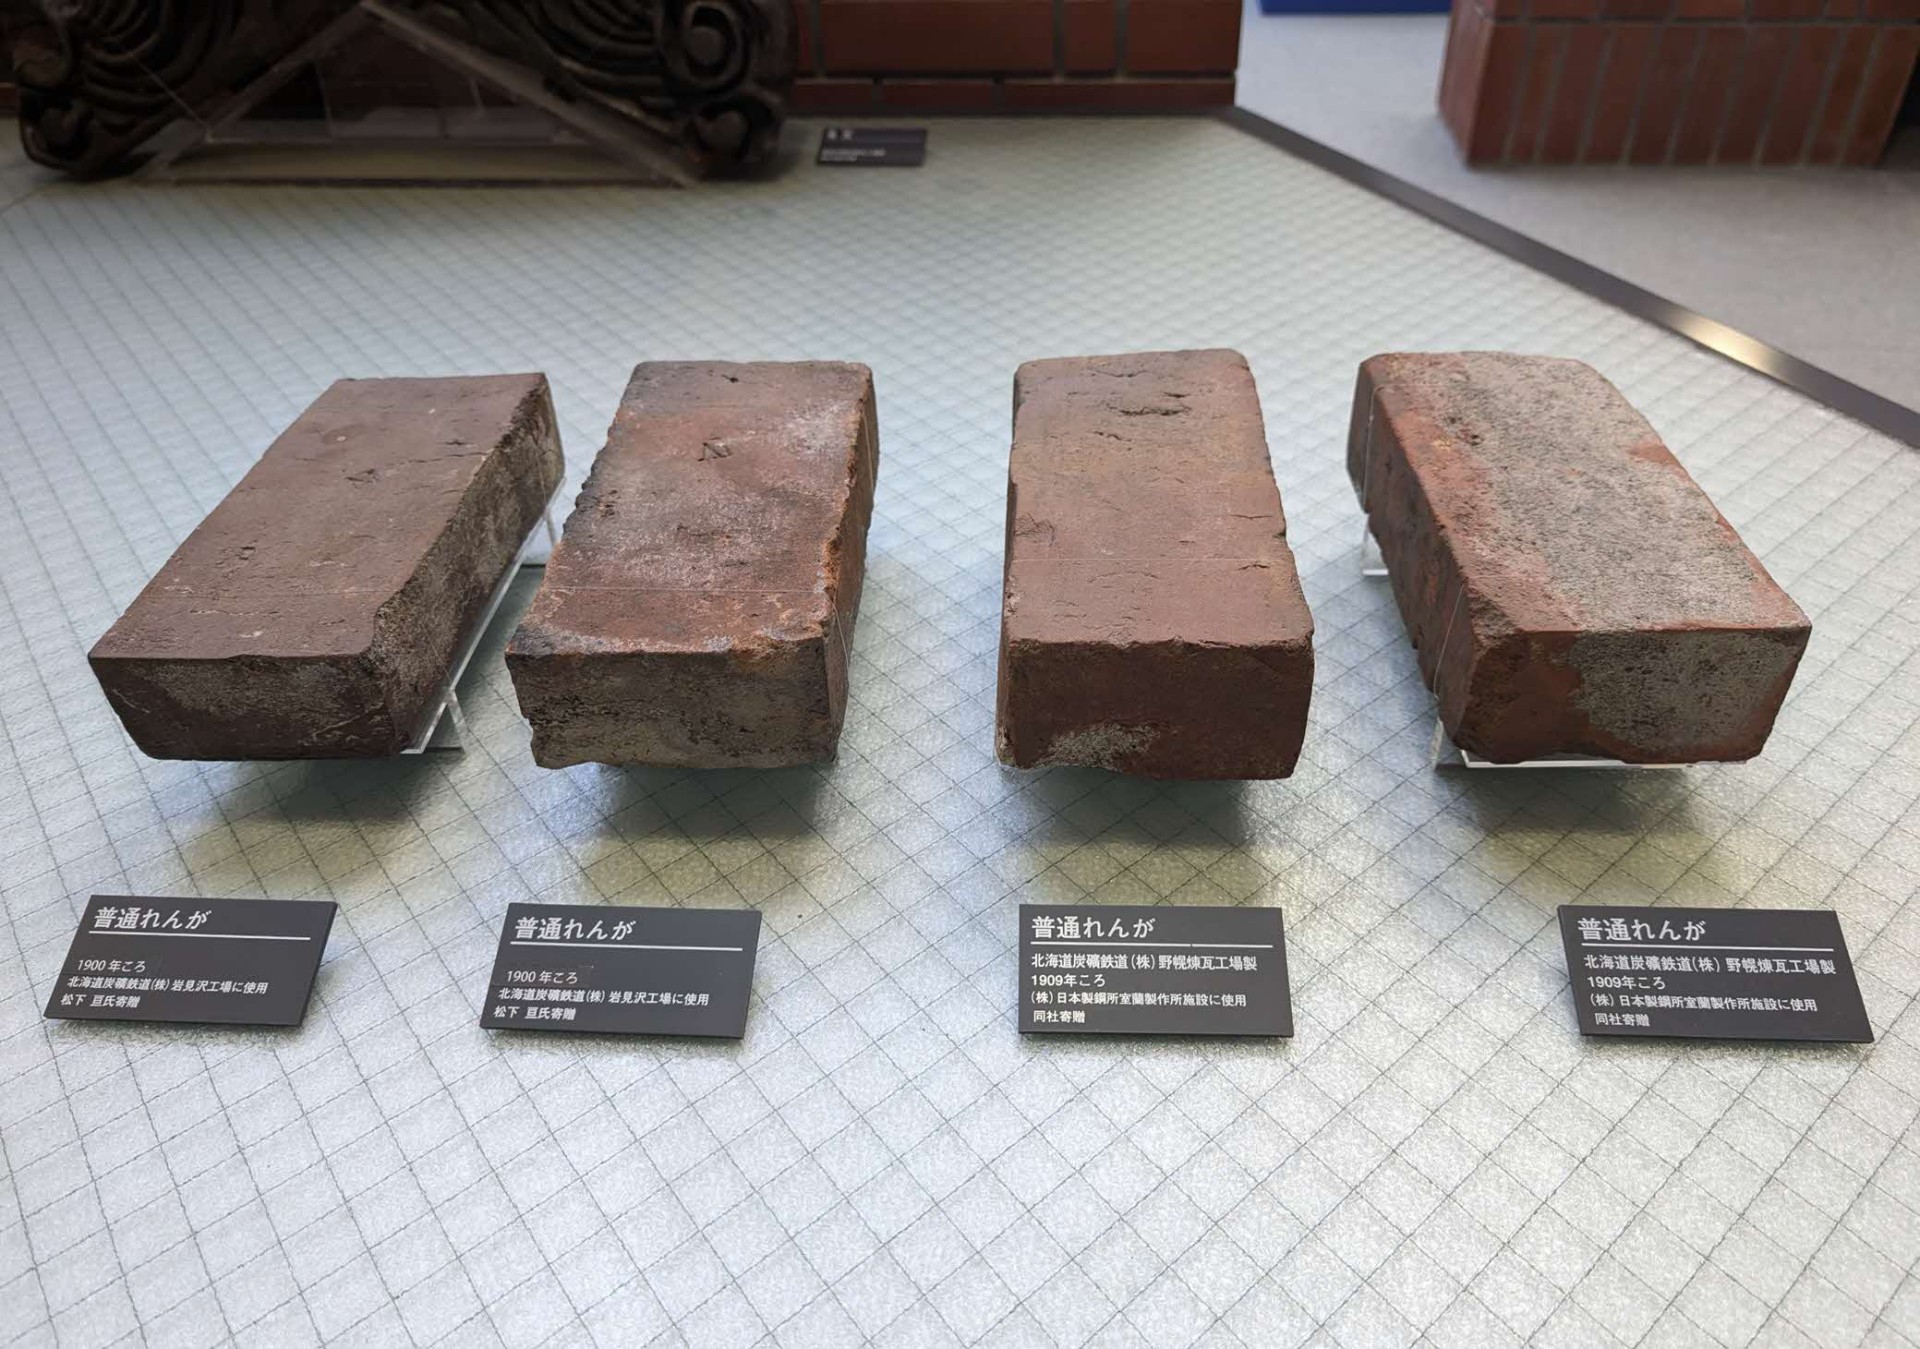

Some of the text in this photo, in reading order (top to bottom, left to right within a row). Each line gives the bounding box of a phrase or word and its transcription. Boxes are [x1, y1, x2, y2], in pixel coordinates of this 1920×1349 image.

[94, 906, 212, 929] 普通れんが
[515, 917, 636, 941] 普通れんが
[1031, 916, 1155, 940] 普通れんが
[1578, 917, 1706, 941] 普通れんが
[1031, 973, 1106, 988] 1909年ころ
[1587, 975, 1666, 990] 1909年ころ
[1033, 1010, 1086, 1024] 同社寄贈
[1595, 1013, 1650, 1028] 同社寄贈
